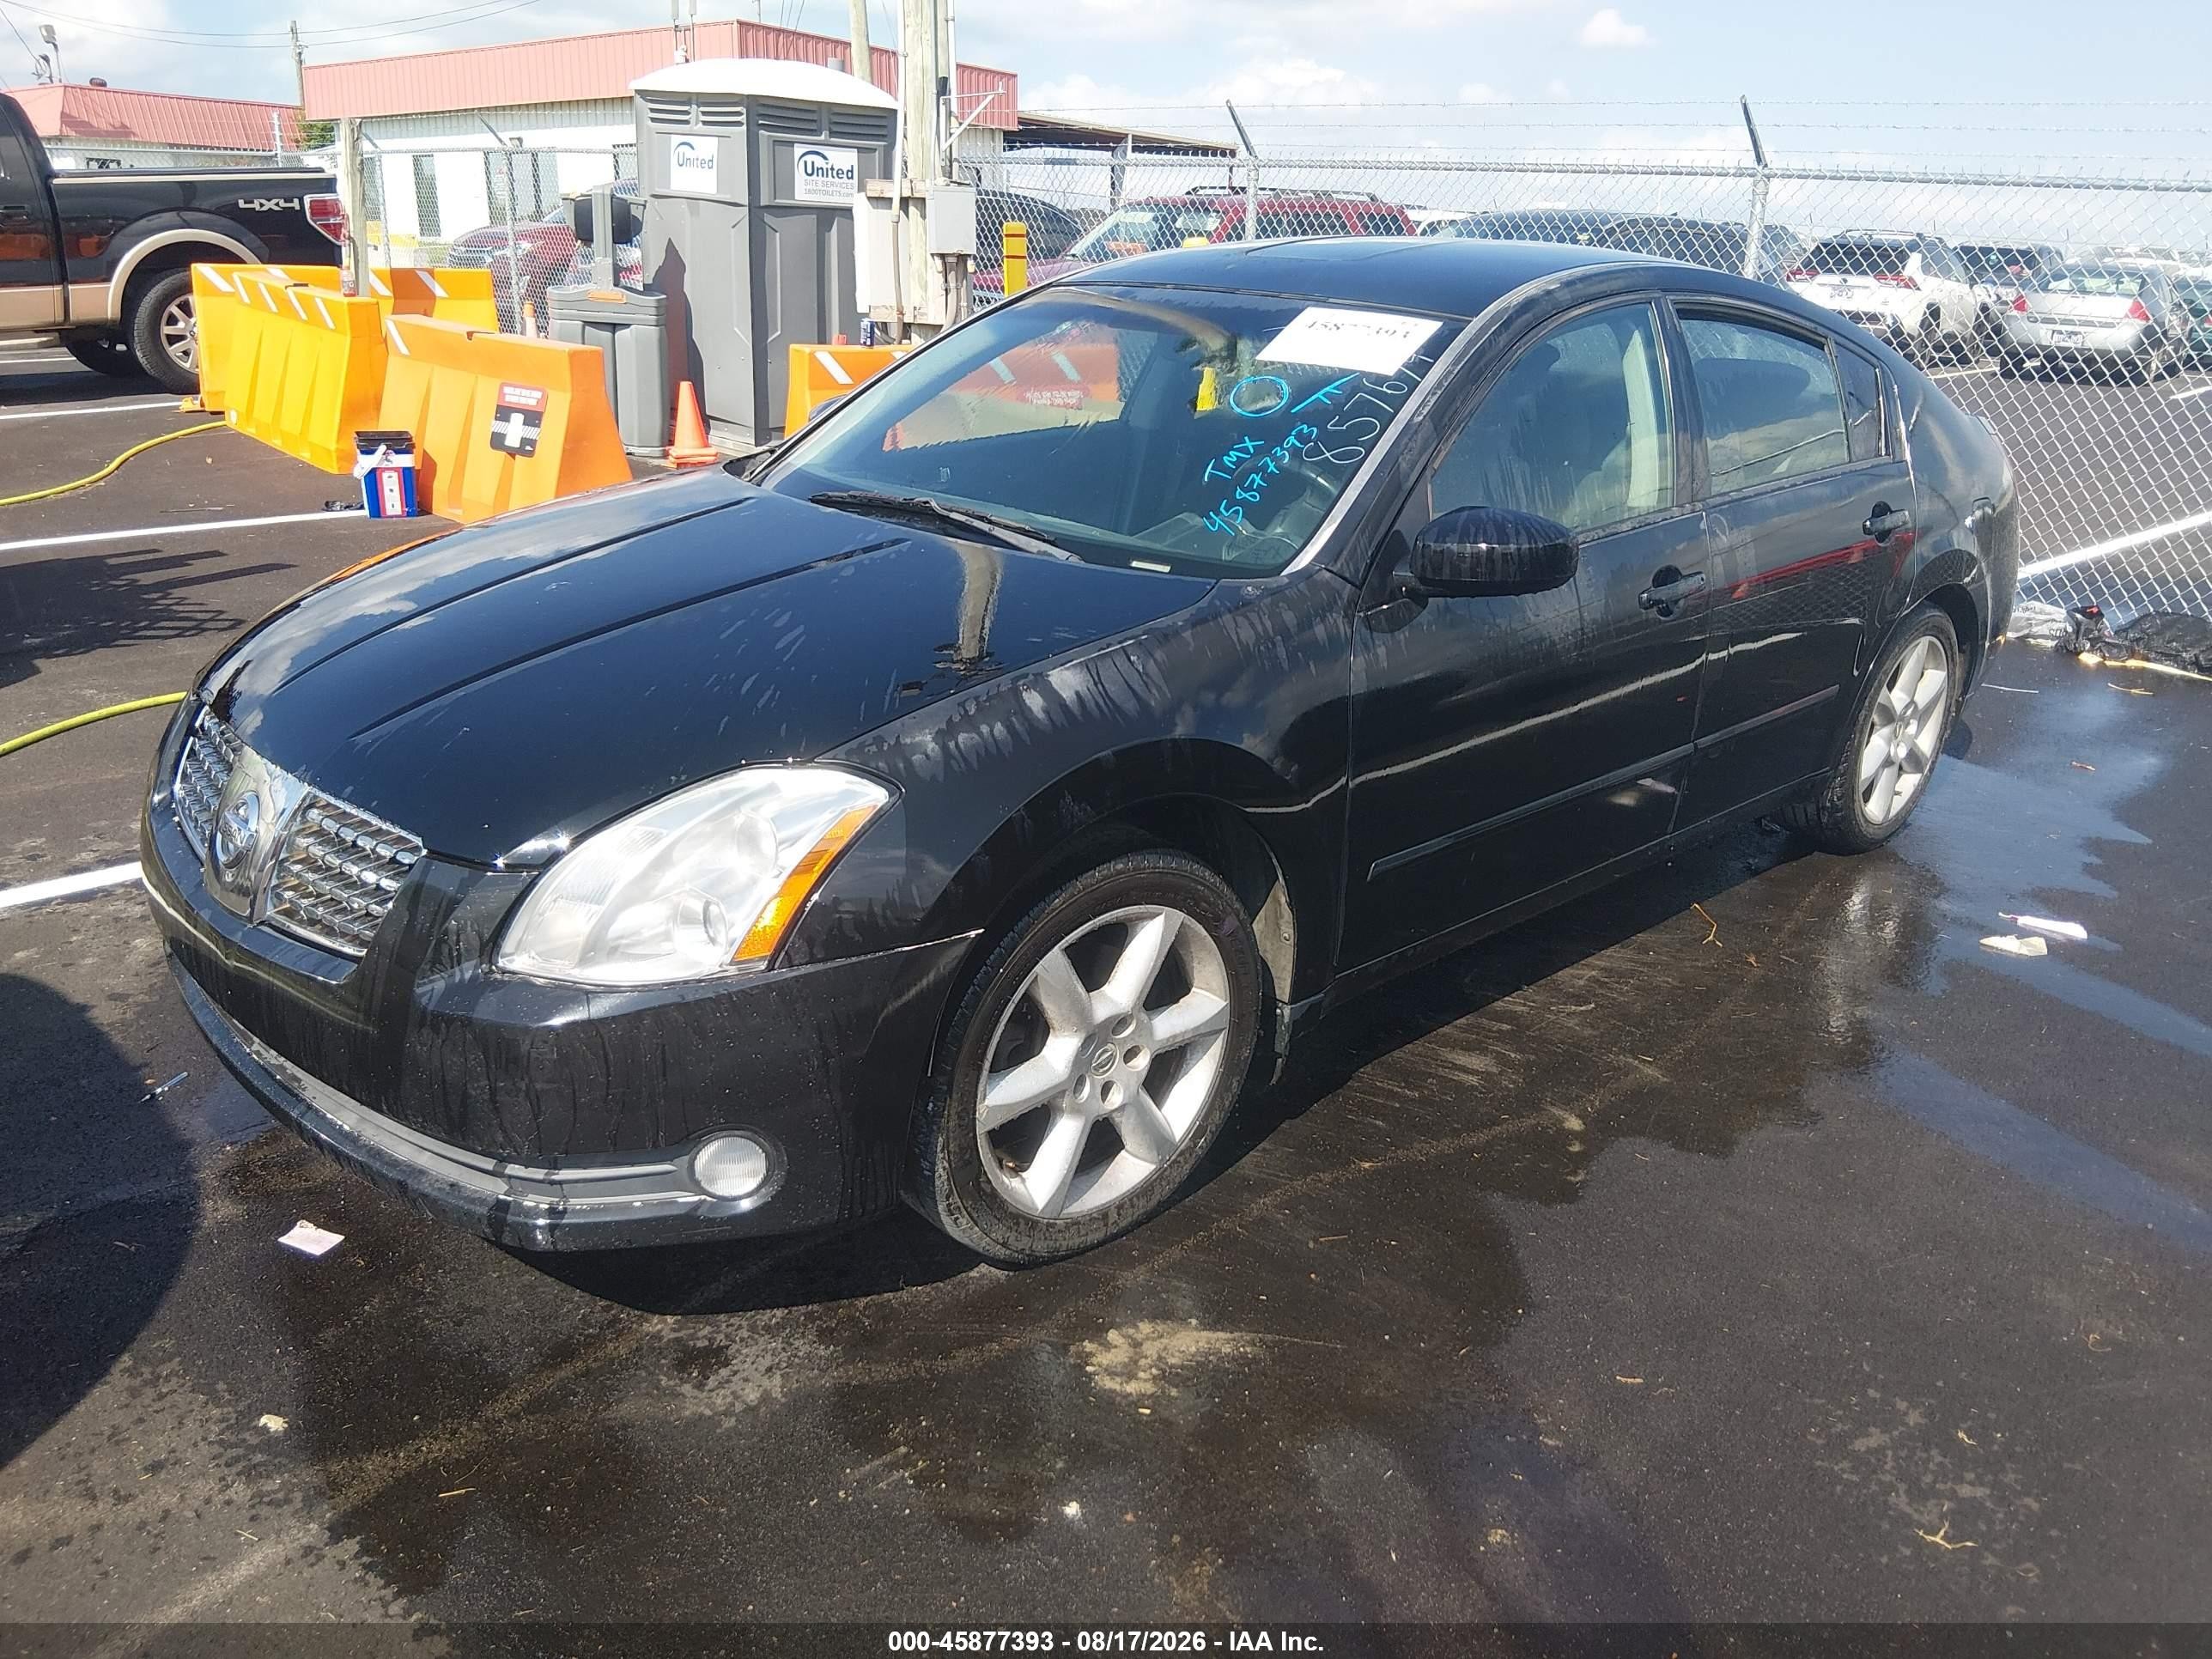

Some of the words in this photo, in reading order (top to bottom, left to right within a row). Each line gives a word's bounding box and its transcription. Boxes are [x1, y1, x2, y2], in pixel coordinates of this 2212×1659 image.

[678, 151, 714, 169] United
[804, 161, 854, 180] United
[821, 180, 854, 191] SERVICES
[1203, 436, 1265, 484] TMX
[1203, 424, 1317, 536] 45877393
